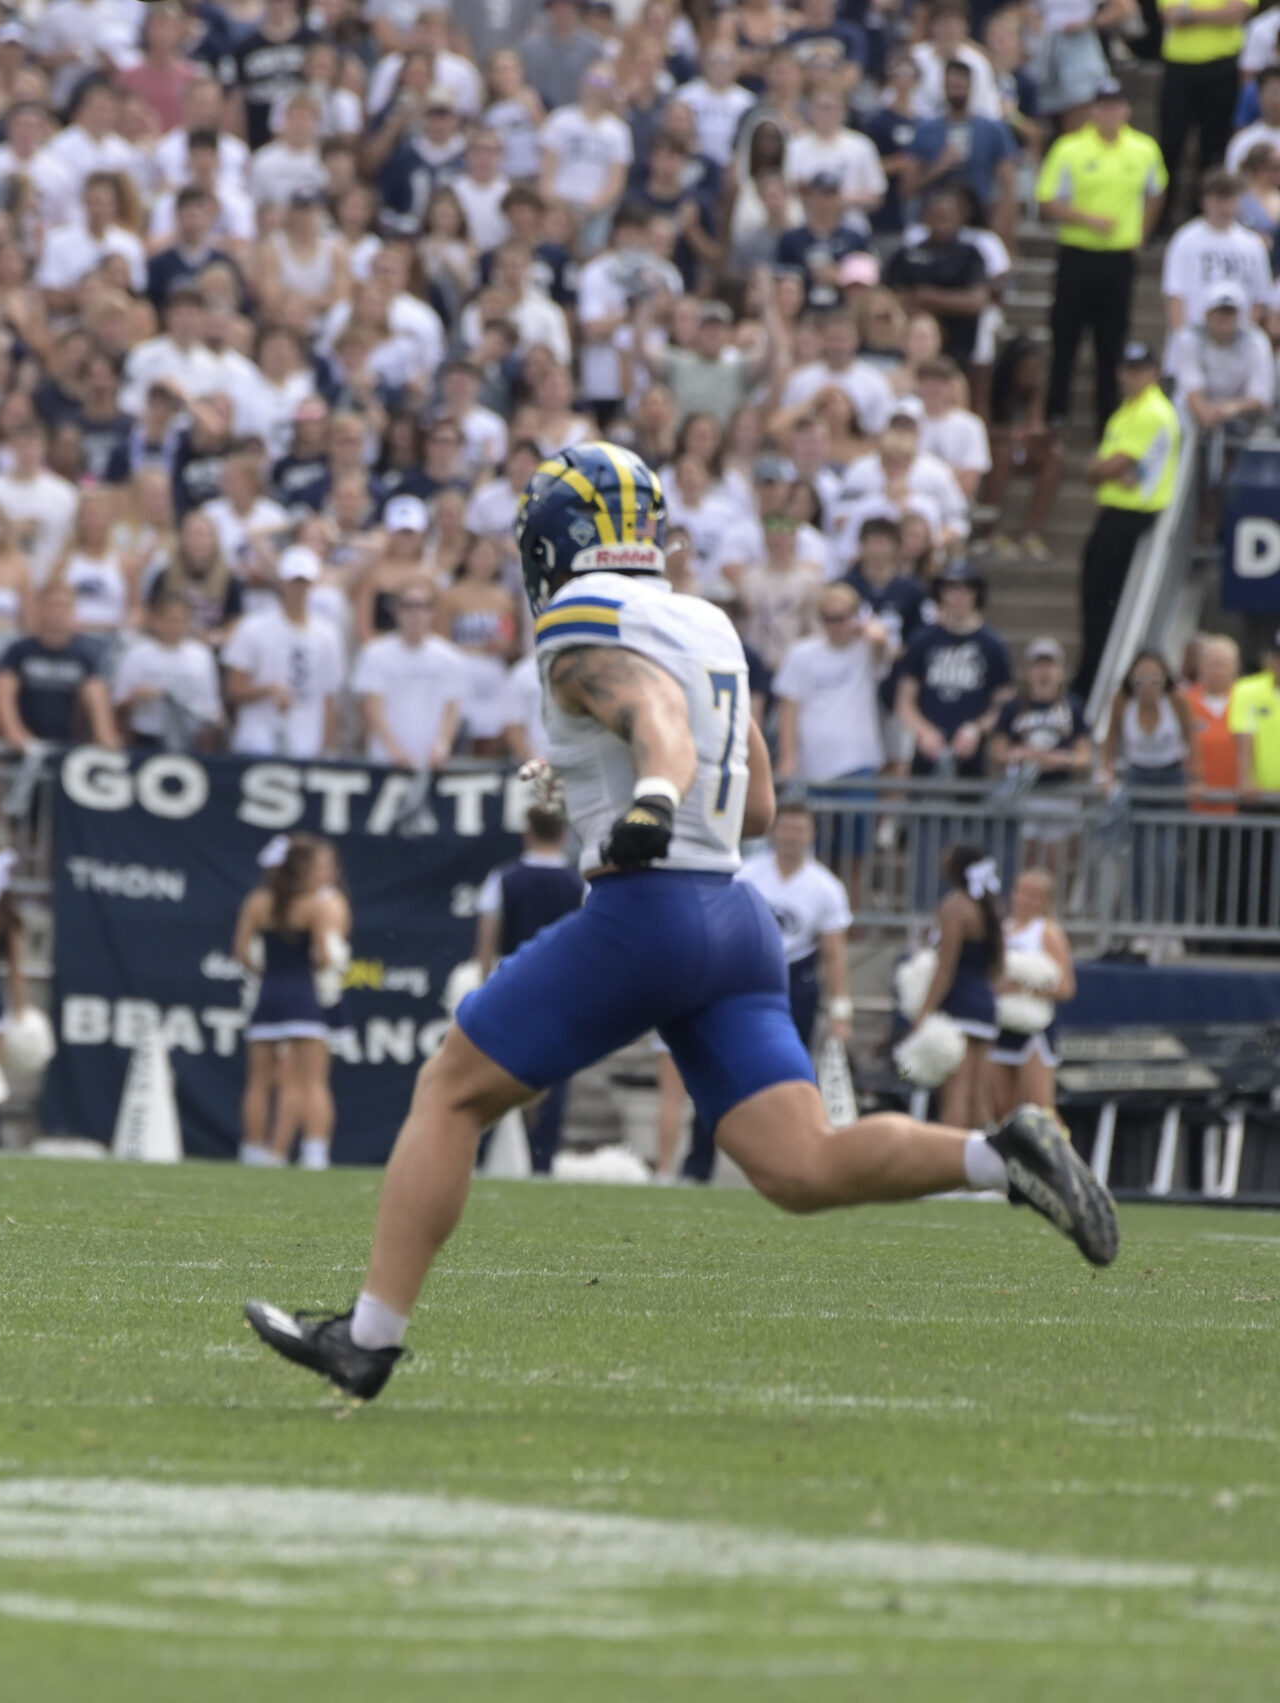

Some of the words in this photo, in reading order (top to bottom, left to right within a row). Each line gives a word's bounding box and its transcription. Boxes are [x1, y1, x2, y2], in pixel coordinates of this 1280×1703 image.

[596, 549, 656, 564] Riddell
[705, 669, 738, 817] 7
[61, 743, 211, 819] GO
[66, 855, 187, 902] THON
